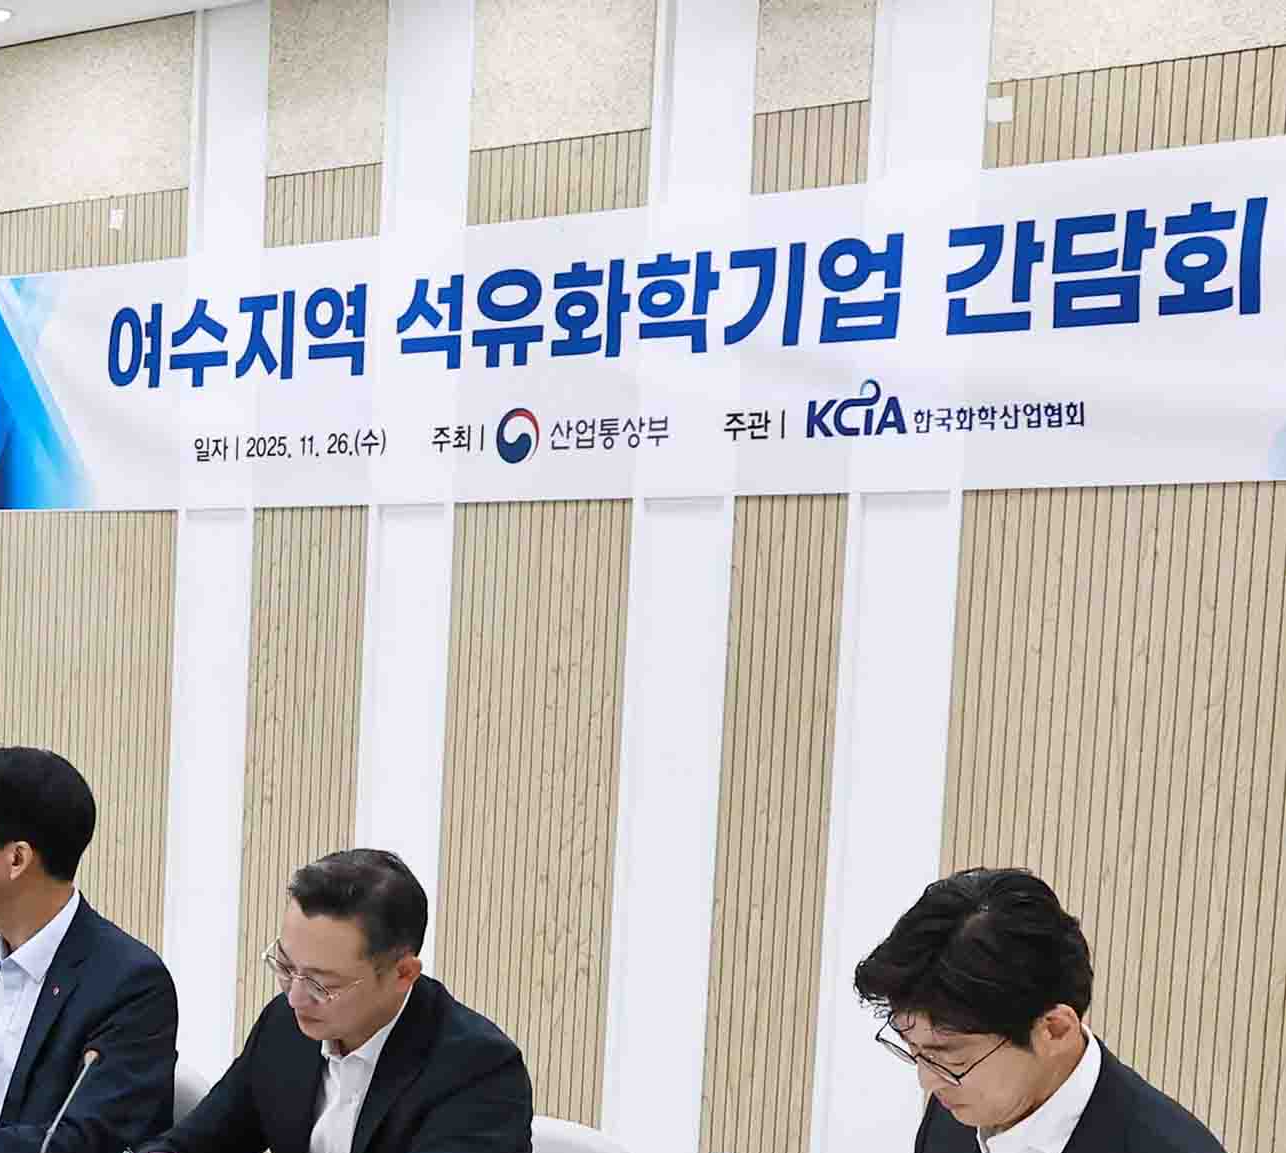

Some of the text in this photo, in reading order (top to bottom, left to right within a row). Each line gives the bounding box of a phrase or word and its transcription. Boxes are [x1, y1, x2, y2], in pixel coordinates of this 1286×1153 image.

[108, 196, 1266, 389] 여수지역 석유화학기업 간담회
[431, 416, 670, 454] 주최 산업통상부
[723, 379, 1086, 441] 주관 KCIA 한국화학산업협회
[194, 435, 229, 462] 일자
[246, 436, 293, 458] 2025.
[299, 435, 320, 458] 11.
